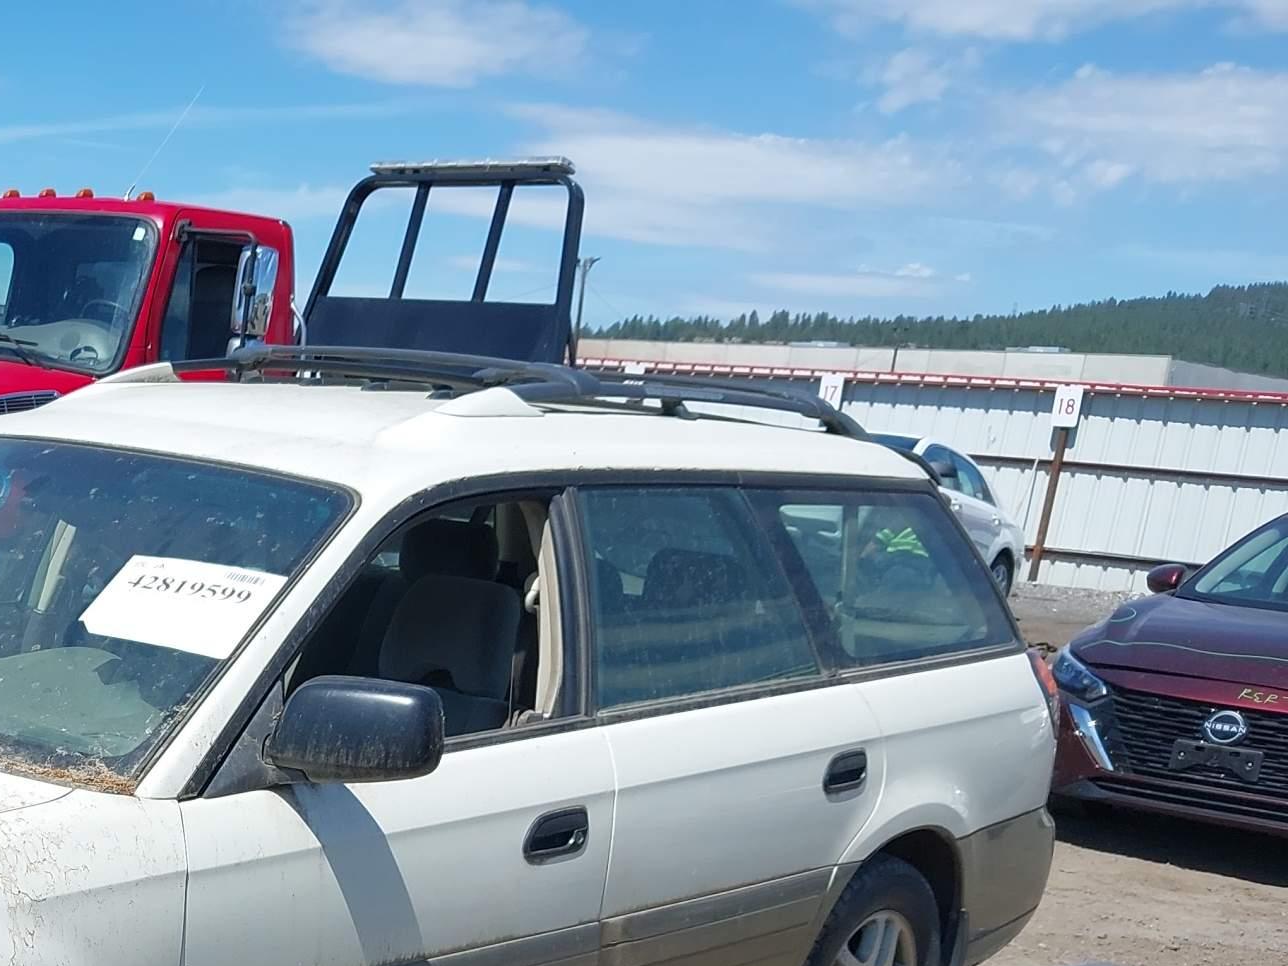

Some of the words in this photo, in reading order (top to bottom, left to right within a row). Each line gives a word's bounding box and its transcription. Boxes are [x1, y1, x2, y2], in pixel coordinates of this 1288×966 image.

[823, 385, 839, 401] 17
[1058, 398, 1075, 415] 18
[128, 574, 252, 604] 42819599
[1204, 721, 1247, 734] NISSAN
